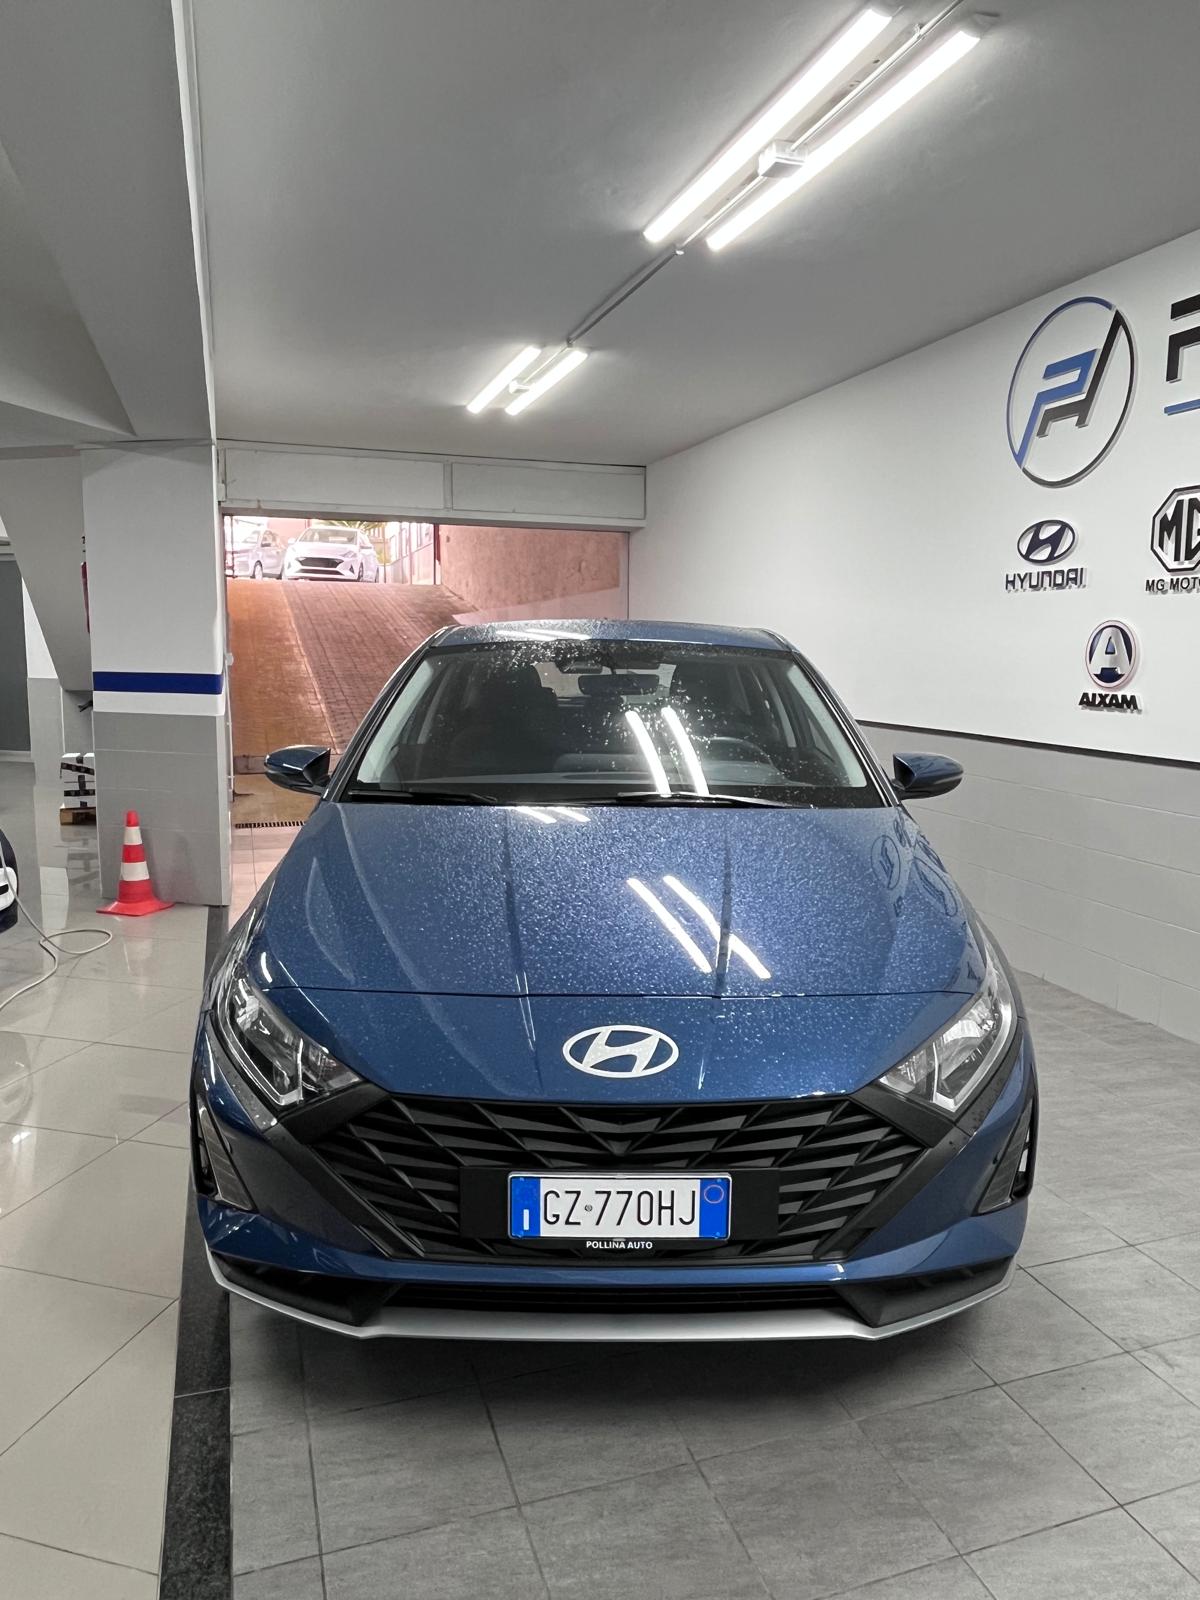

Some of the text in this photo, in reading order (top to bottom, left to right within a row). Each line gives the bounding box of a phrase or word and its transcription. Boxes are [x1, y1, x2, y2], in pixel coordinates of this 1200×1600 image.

[1158, 498, 1200, 561] MG
[1005, 567, 1084, 591] HYUNDAI
[1145, 576, 1200, 592] MG MOT
[1078, 692, 1139, 711] AIXAM
[585, 1240, 654, 1250] POLLINA AUTO
